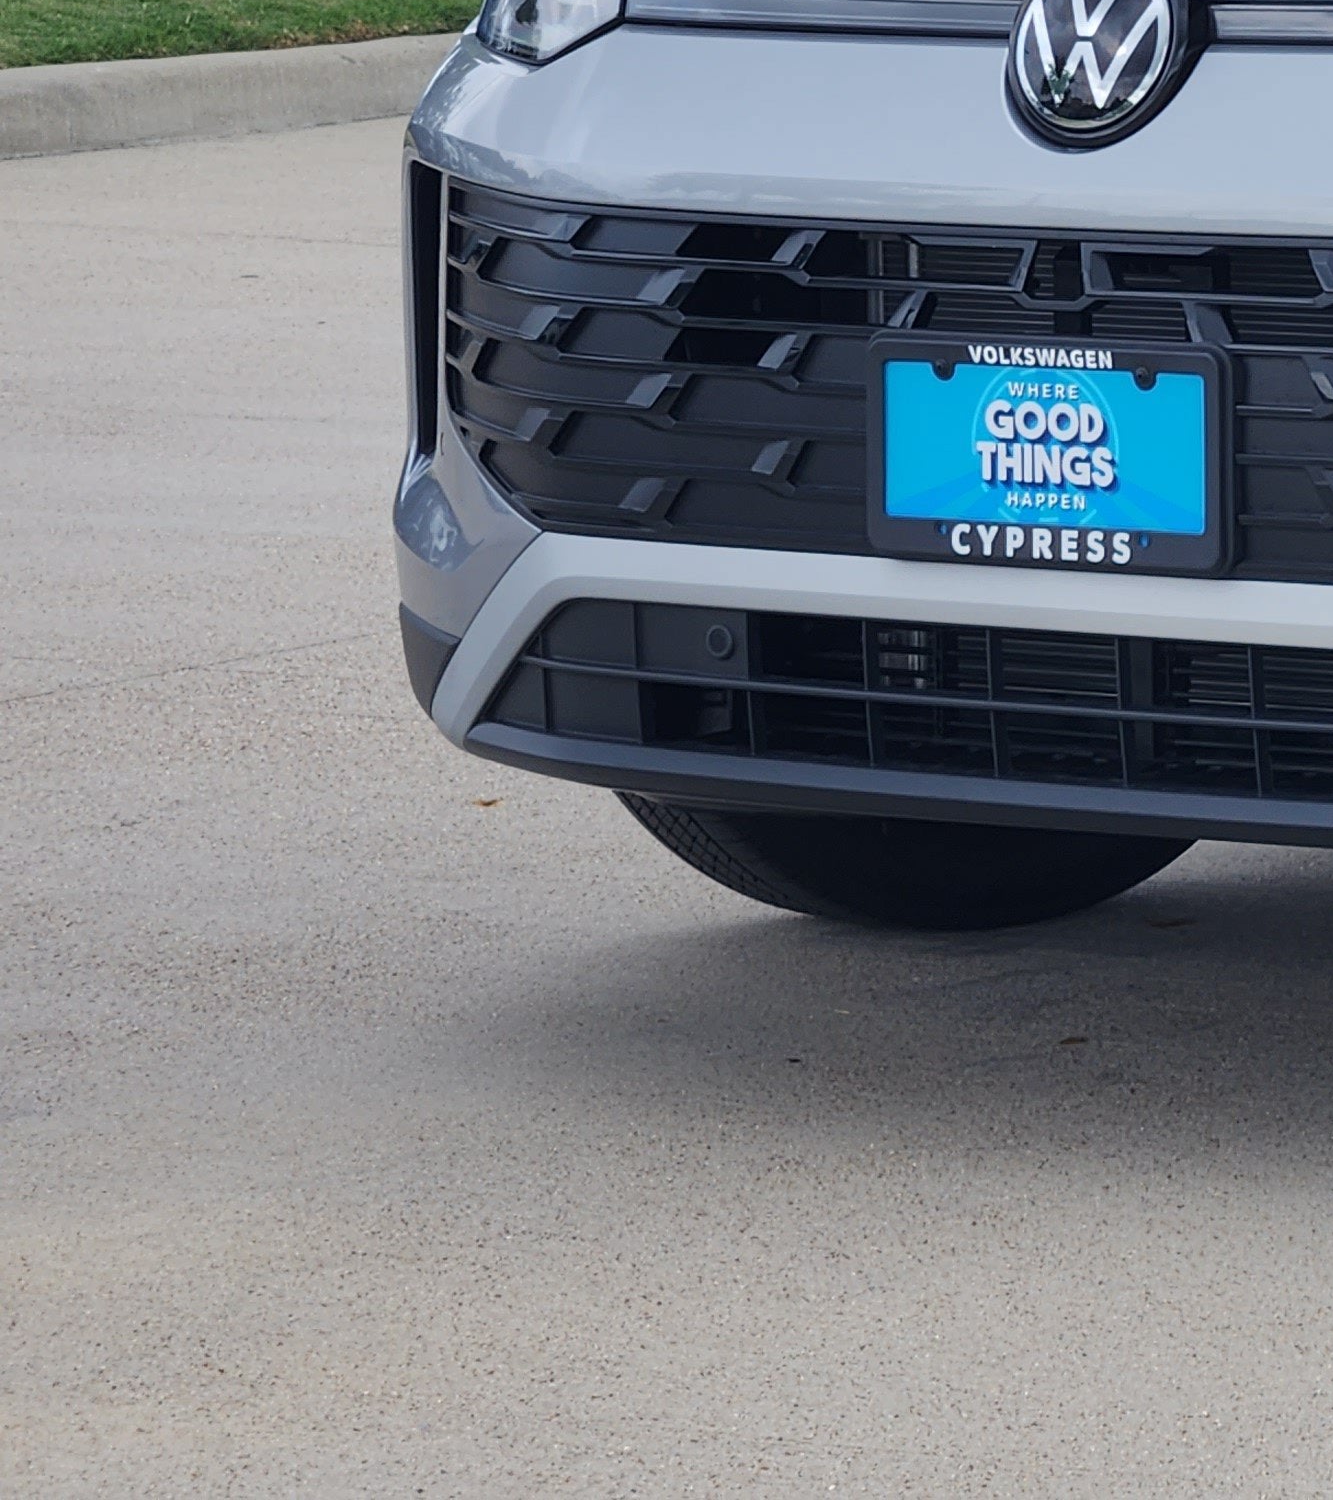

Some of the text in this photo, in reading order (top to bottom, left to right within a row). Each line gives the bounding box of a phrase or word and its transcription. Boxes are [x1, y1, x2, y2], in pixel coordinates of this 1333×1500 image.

[967, 344, 1114, 370] VOLKSWAGEN
[1007, 381, 1080, 400] WHERE
[983, 399, 1105, 443] GOOD
[975, 441, 1116, 488] THINGS
[1004, 492, 1087, 511] HAPPEN
[950, 523, 1133, 565] CYPRESS
